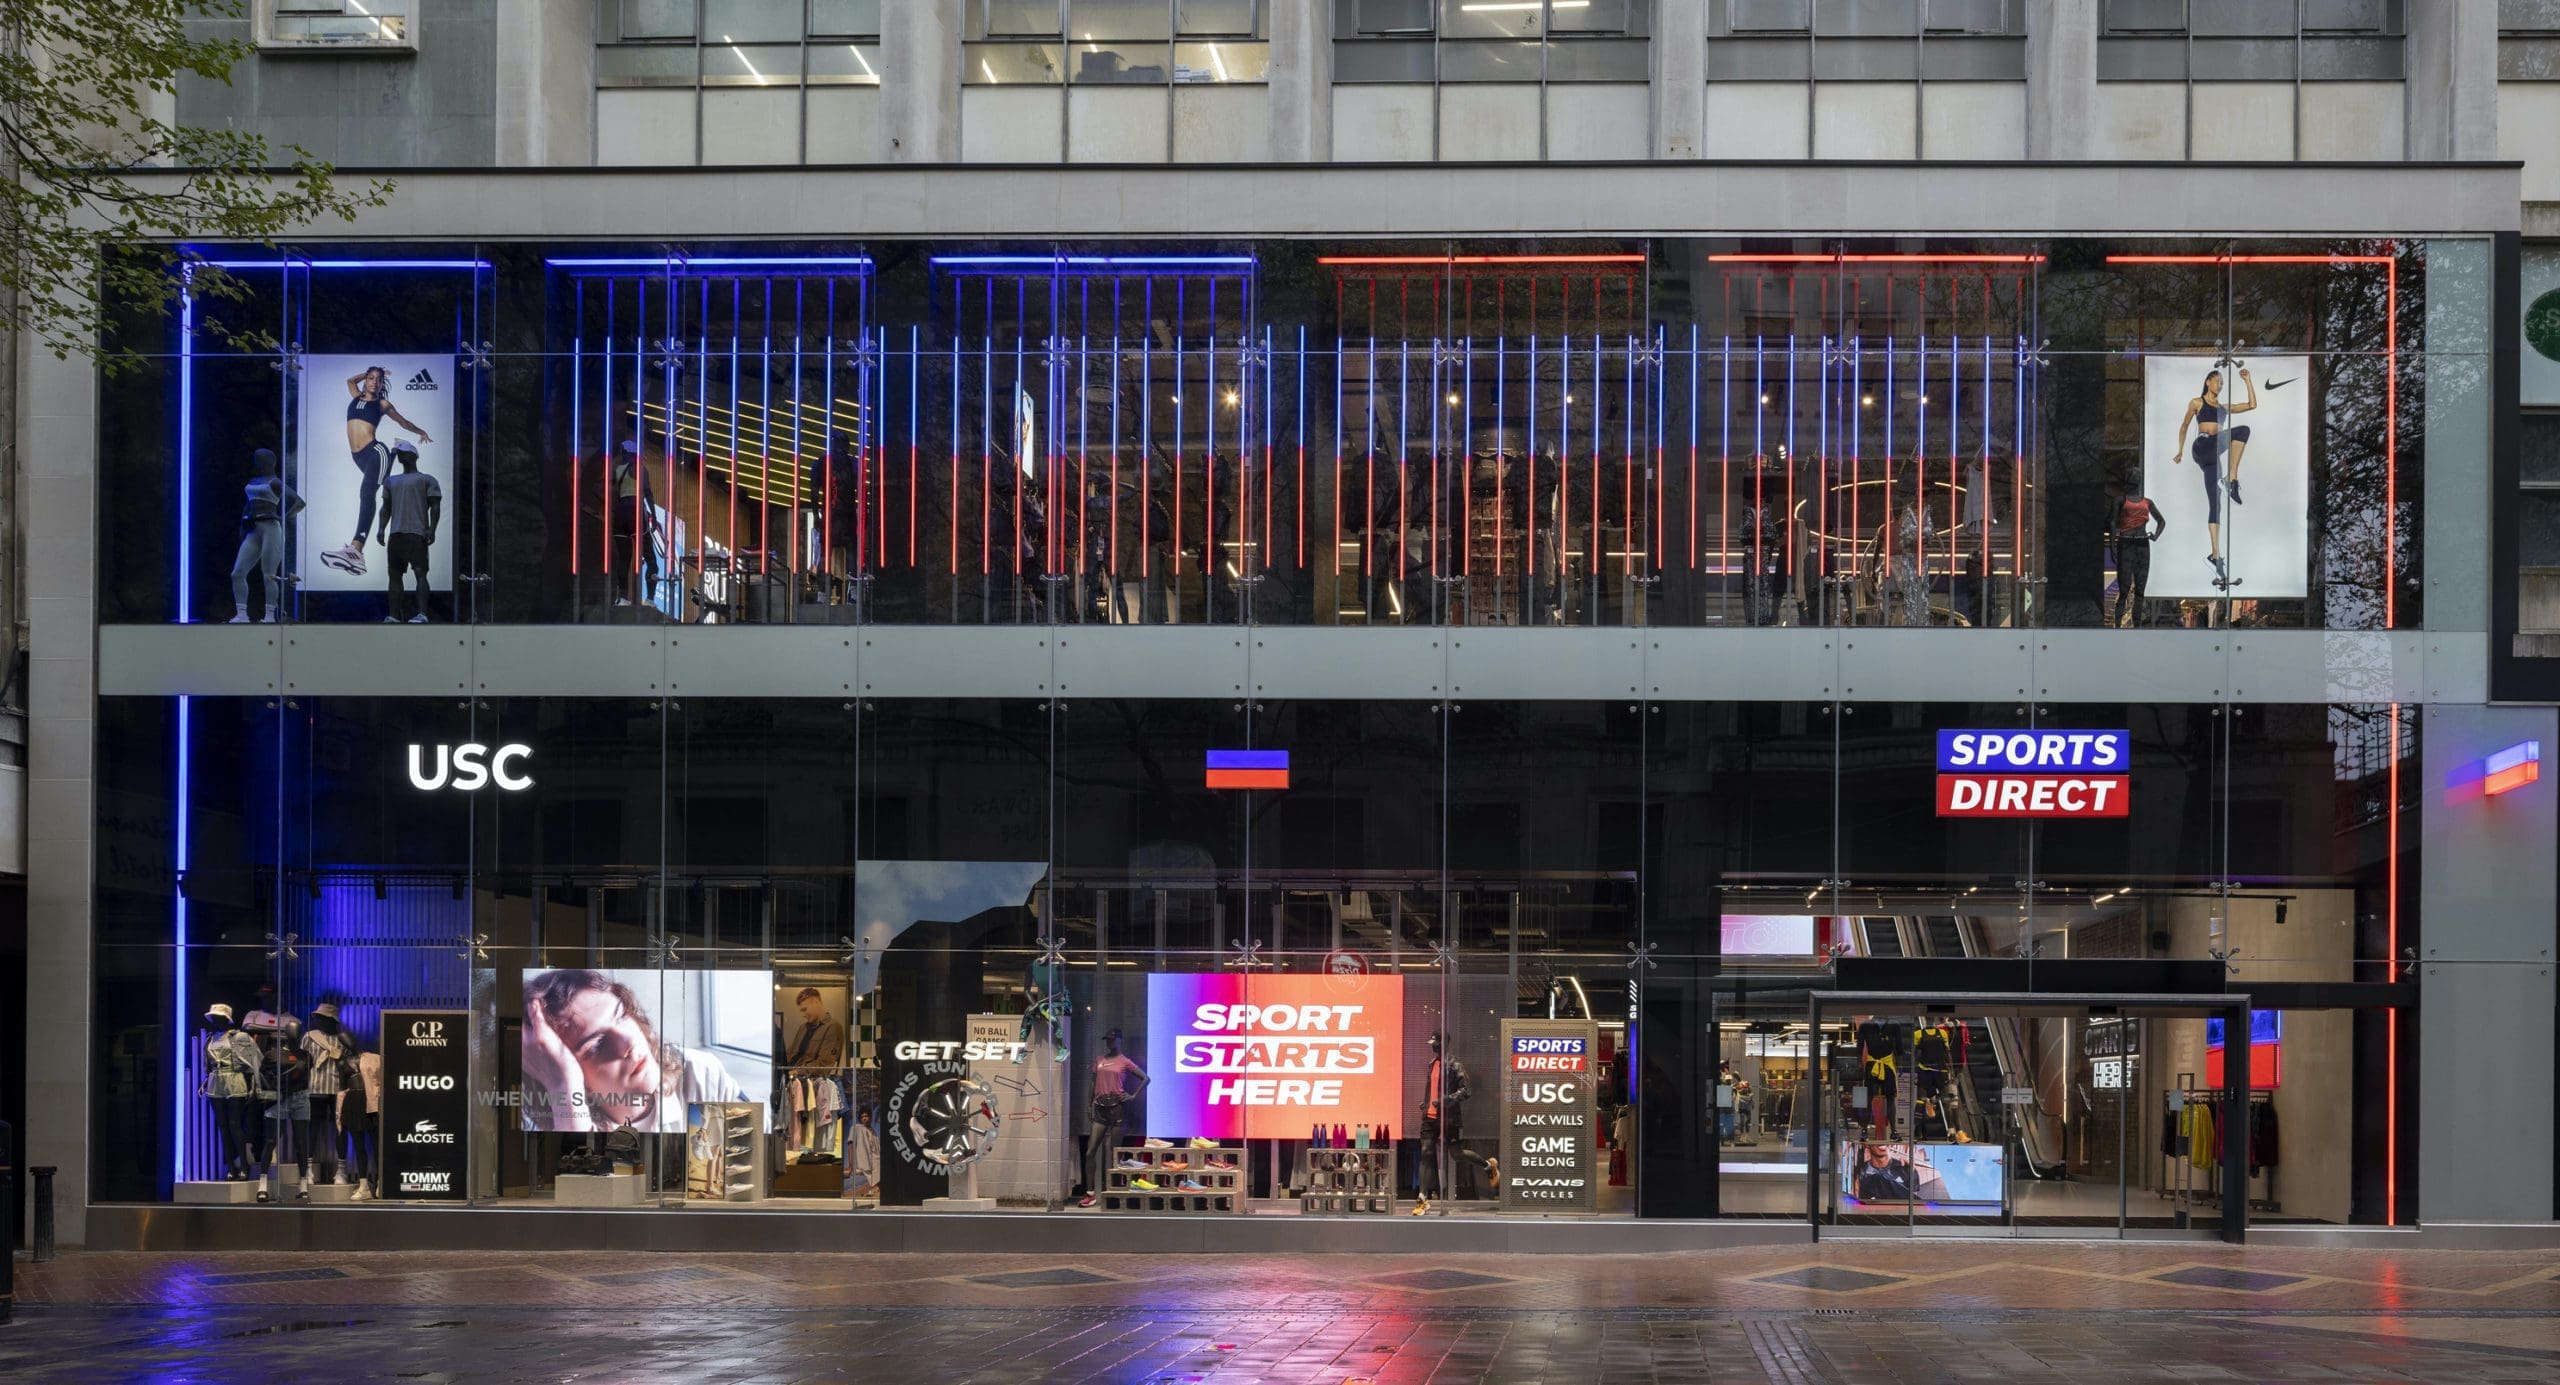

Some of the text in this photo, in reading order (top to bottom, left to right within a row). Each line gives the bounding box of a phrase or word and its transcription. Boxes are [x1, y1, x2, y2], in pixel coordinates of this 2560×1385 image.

[405, 382, 438, 391] adidas
[1950, 734, 2118, 766] SPORTS
[408, 743, 536, 791] USC
[1950, 779, 2117, 811] DIRECT
[1192, 1003, 1363, 1031] SPORT
[411, 1021, 443, 1038] C.P.
[973, 1026, 1008, 1036] NO BALL
[406, 1038, 448, 1047] COMPANY
[1517, 1039, 1581, 1053] SPORTS
[894, 1041, 1026, 1061] GET SET
[1180, 1041, 1368, 1069] STARTS
[923, 1061, 966, 1076] RUN
[1517, 1057, 1581, 1069] DIRECT
[399, 1075, 454, 1090] HUGO
[477, 1091, 656, 1107] WHEN WE SUMMER
[1208, 1079, 1343, 1106] HERE
[1522, 1083, 1575, 1103] USC
[888, 1071, 919, 1163] REASONS
[1514, 1114, 1584, 1126] JACK WILLS
[398, 1133, 454, 1143] LACOSTE
[1522, 1137, 1575, 1153] GAME
[918, 1161, 966, 1176] OWN
[1521, 1156, 1575, 1167] BELONG
[401, 1172, 450, 1183] TOMMY
[1511, 1178, 1584, 1187] EVANS
[420, 1183, 450, 1192] JEANS
